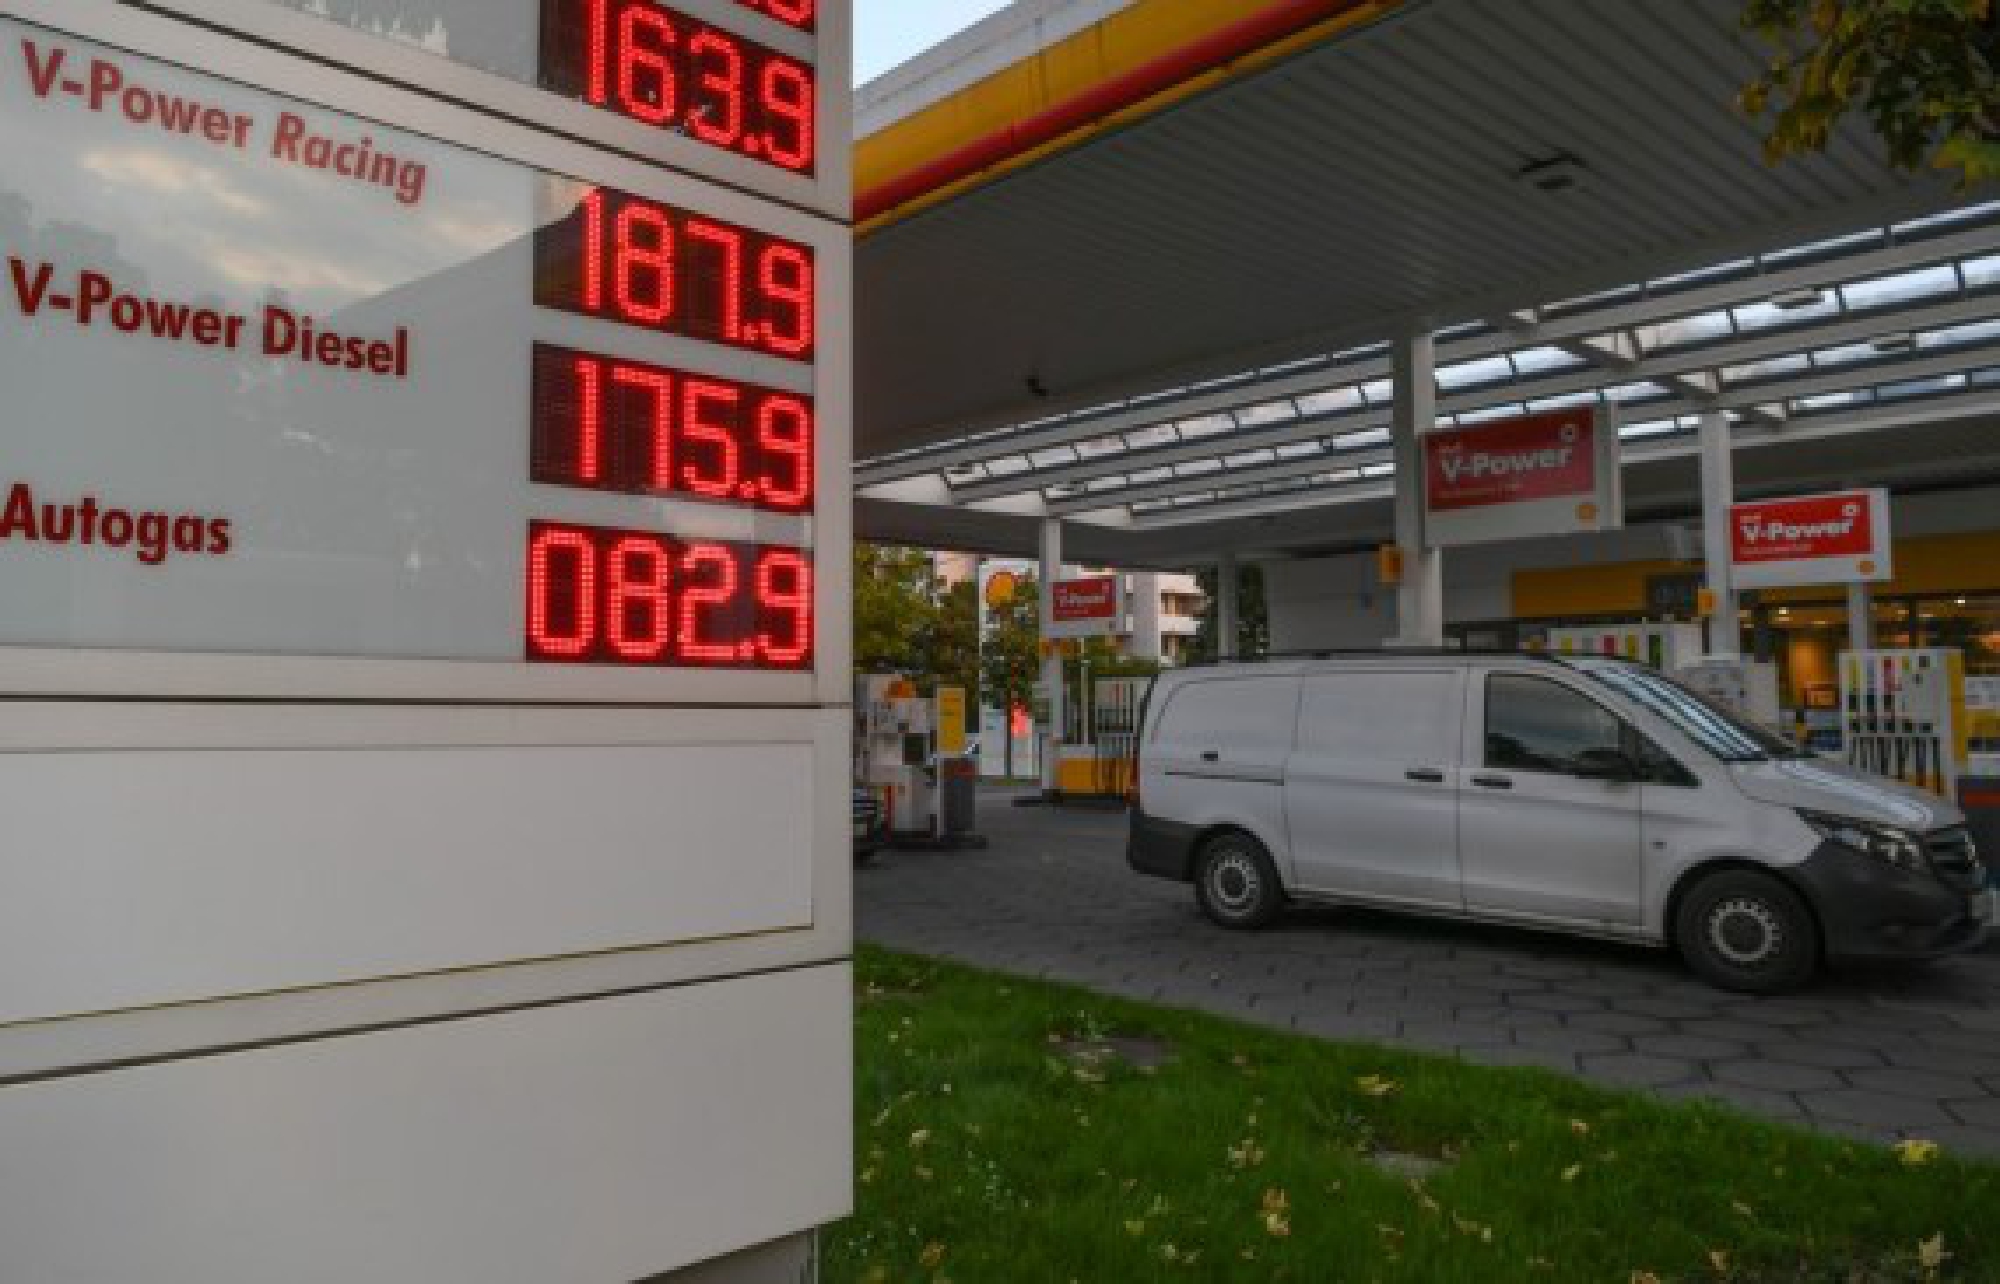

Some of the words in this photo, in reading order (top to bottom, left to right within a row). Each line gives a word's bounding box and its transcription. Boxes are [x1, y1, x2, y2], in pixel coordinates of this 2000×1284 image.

[21, 39, 254, 148] V-Power
[270, 111, 427, 204] Racing
[589, 0, 812, 168] 163.9
[8, 255, 247, 350] V-Power
[262, 304, 409, 377] Diesel
[582, 187, 812, 352] 187.9
[575, 359, 809, 506] 175.9
[1441, 448, 1573, 485] V-Power
[0, 483, 231, 565] Autogas
[1740, 519, 1854, 545] V-Power
[532, 530, 812, 661] 082.9
